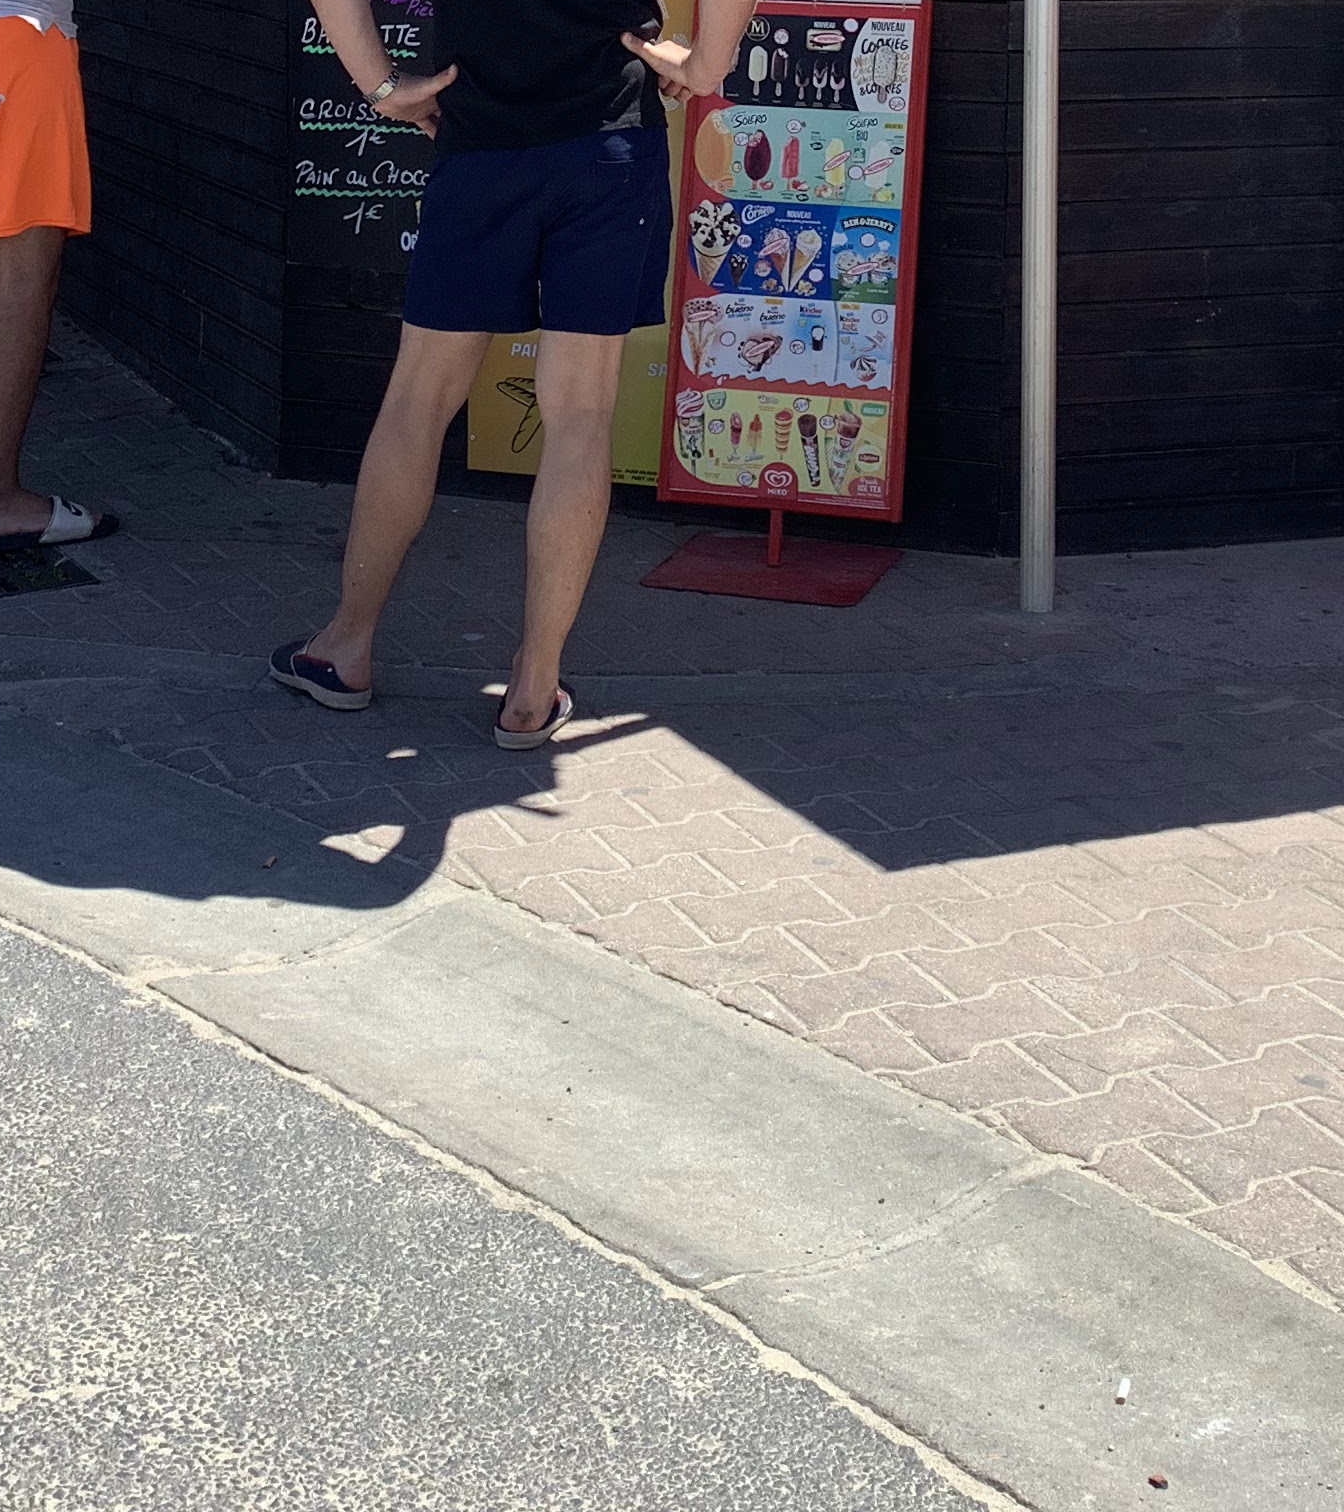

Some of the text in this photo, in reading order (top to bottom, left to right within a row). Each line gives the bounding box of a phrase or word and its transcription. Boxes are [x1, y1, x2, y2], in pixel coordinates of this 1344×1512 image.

[870, 20, 906, 32] NOUVEAU
[343, 201, 385, 235] 1€
[511, 342, 537, 358] PAI
[647, 362, 667, 377] SA
